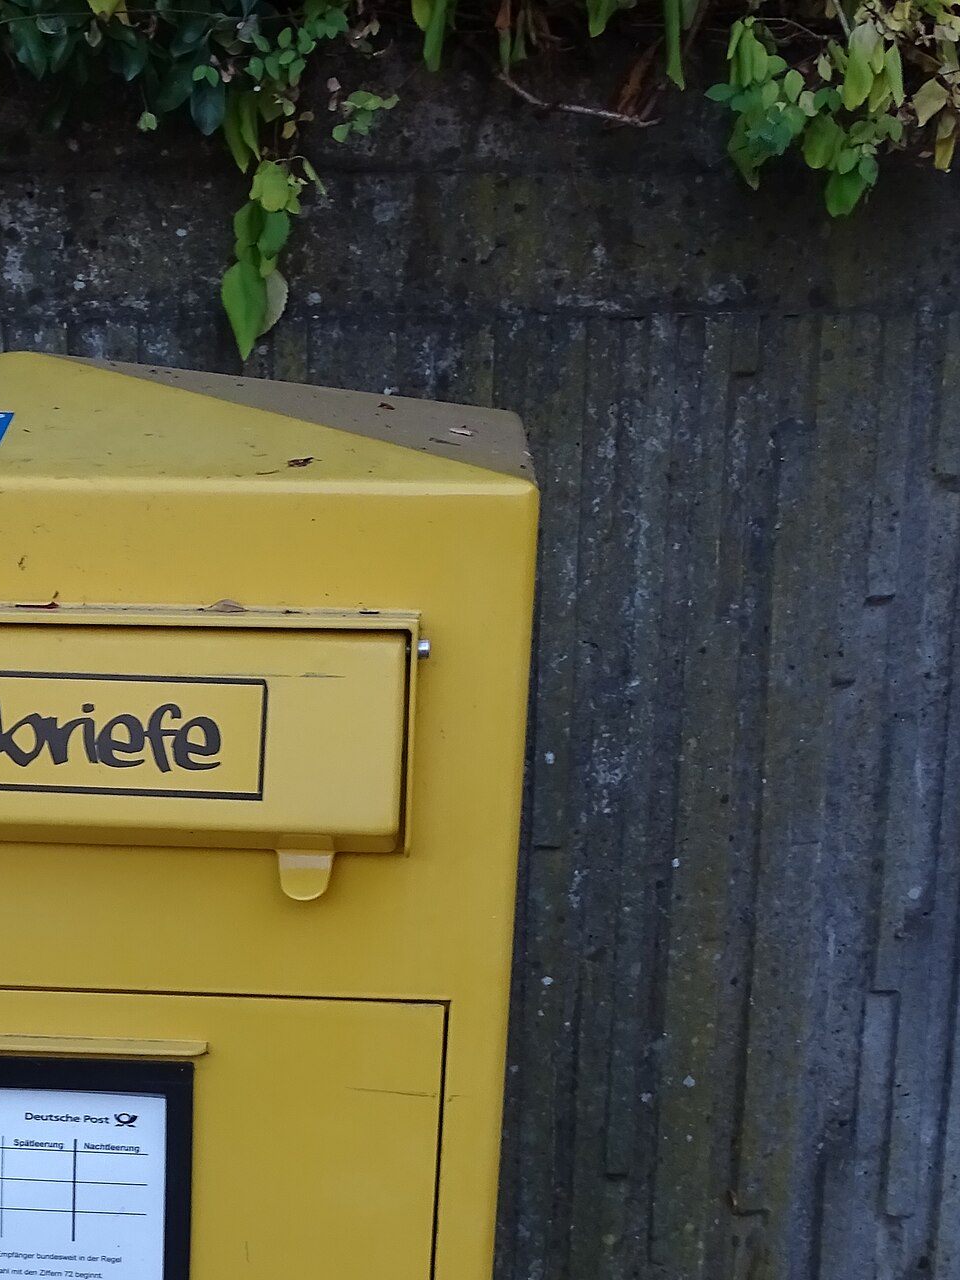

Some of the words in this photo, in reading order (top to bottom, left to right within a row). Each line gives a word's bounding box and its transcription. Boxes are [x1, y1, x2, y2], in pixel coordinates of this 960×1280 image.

[24, 1112, 81, 1123] Deutsche
[83, 1115, 110, 1124] Post
[13, 1139, 64, 1149] Spätleerung
[83, 1142, 140, 1153] Nachtleerung
[36, 1253, 76, 1261] bundesweit
[100, 1255, 122, 1264] Regel
[39, 1269, 62, 1277] Ziffern
